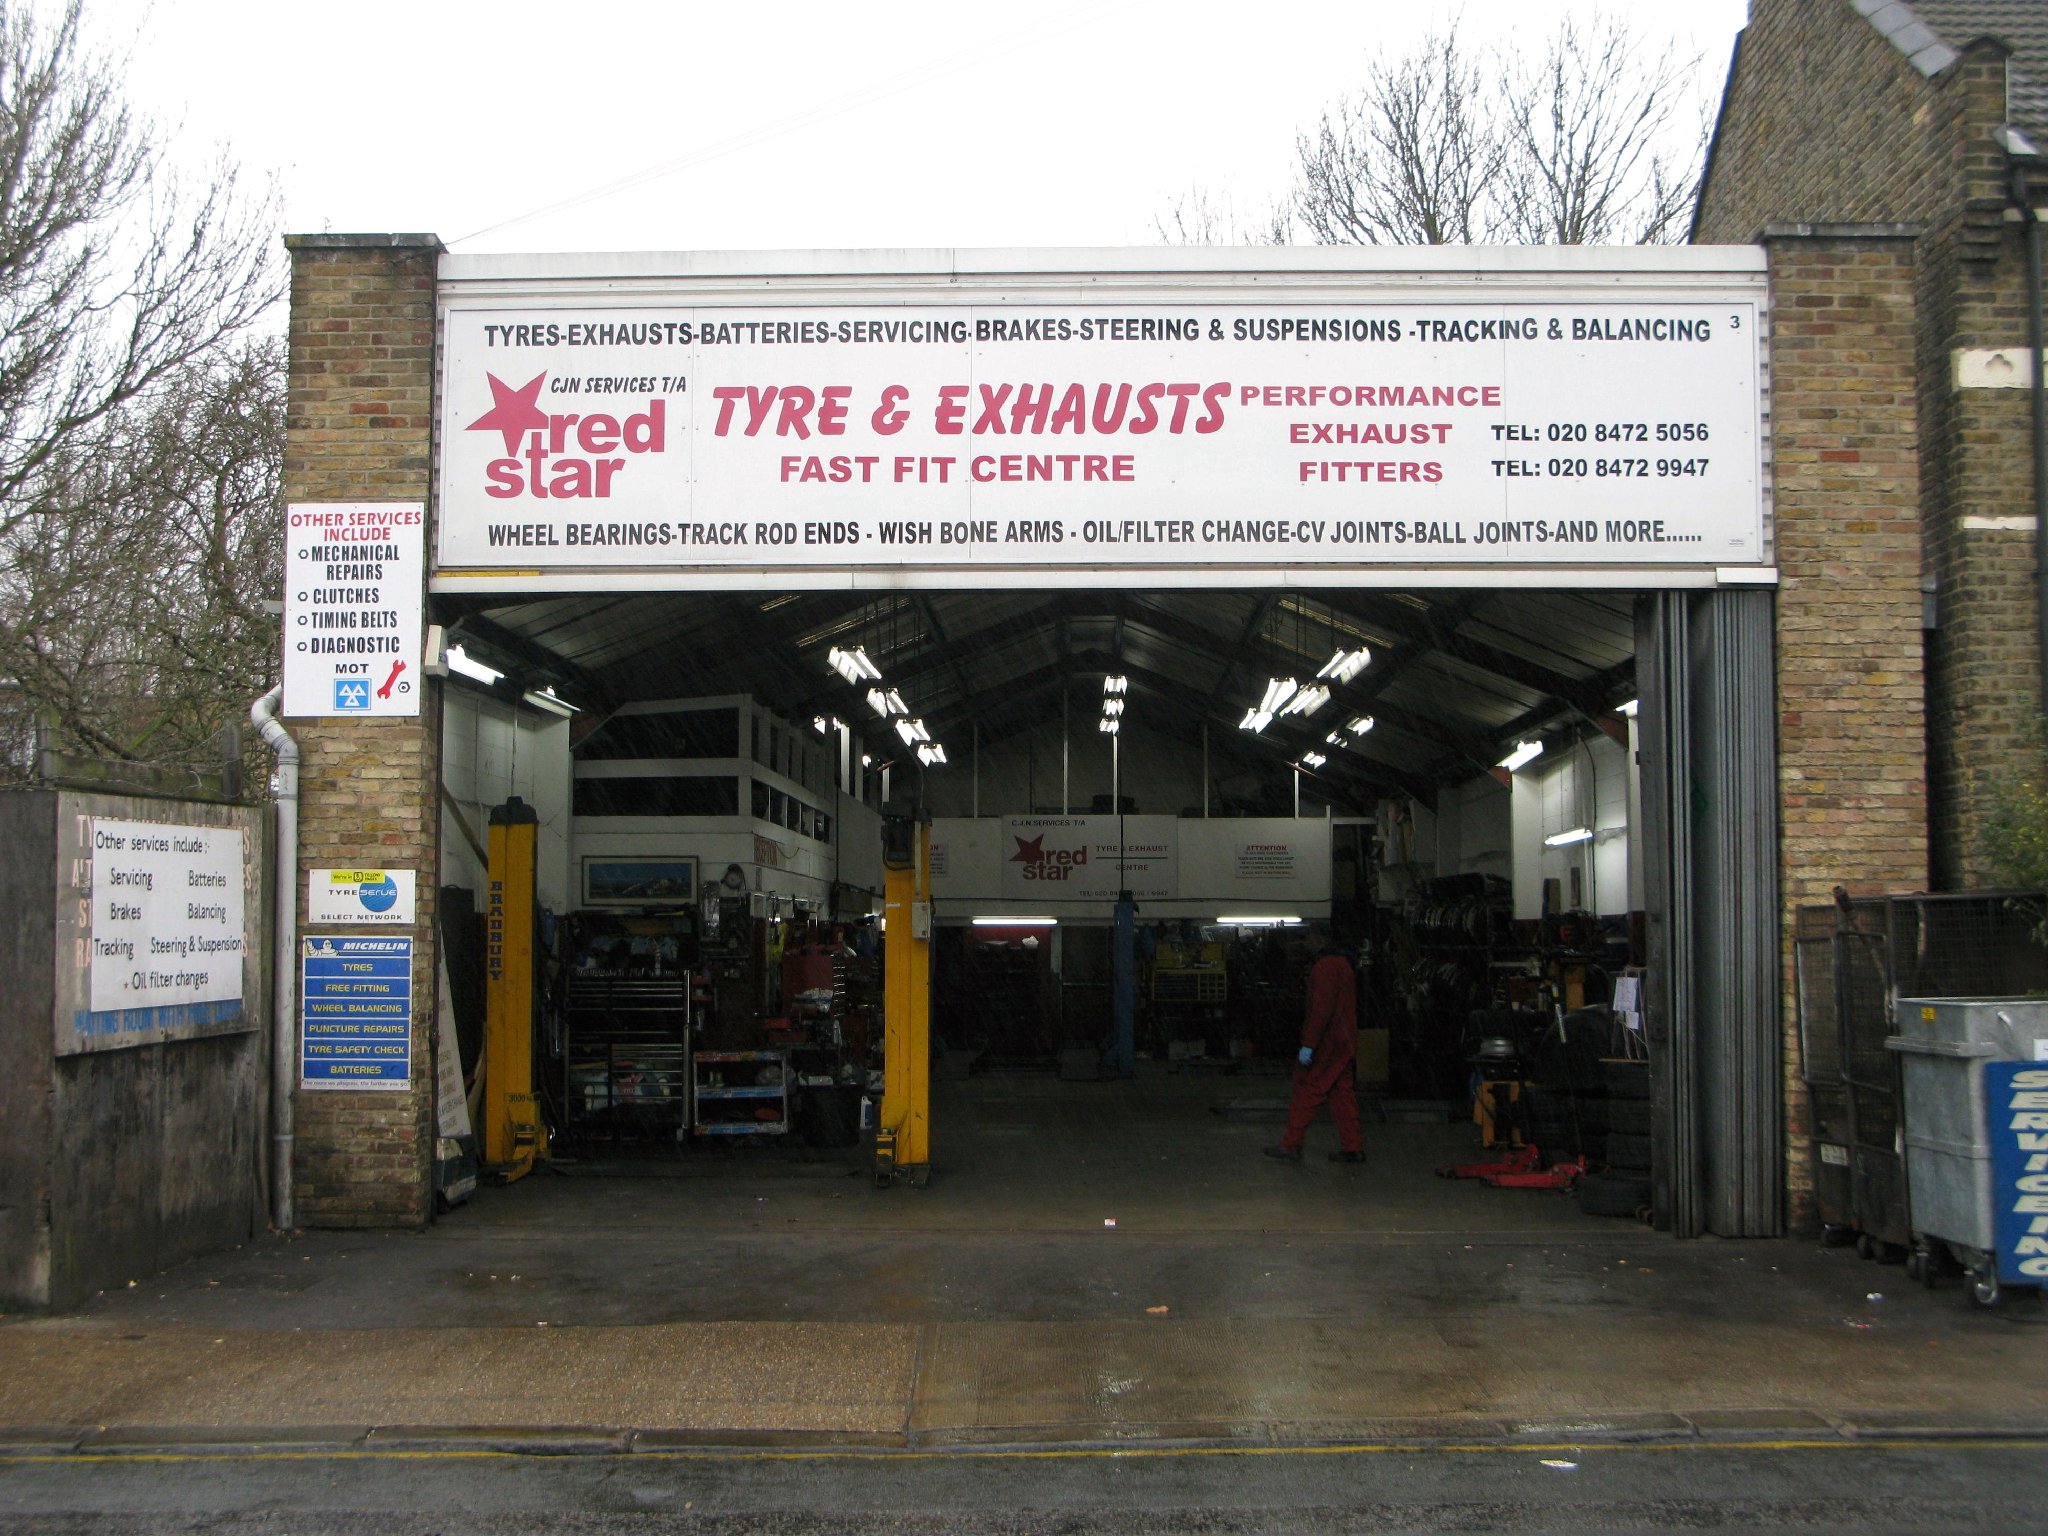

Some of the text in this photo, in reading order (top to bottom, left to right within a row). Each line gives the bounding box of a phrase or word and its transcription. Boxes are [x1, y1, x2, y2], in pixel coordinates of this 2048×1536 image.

[1208, 319, 1225, 341] &
[1233, 319, 1401, 342] SUSPENSIONS
[1547, 318, 1564, 341] &
[1573, 319, 1711, 343] BALANCING
[1730, 315, 1741, 329] 3
[550, 375, 687, 394] CJN SERVICES T/A
[1241, 386, 1501, 407] PERFORMANCE
[713, 382, 1232, 440] TYRE & EXHAUSTS
[550, 399, 666, 454] red
[1289, 423, 1453, 445] EXHAUST
[1491, 423, 1709, 442] TEL: 020 8472 5056
[485, 431, 626, 499] star
[780, 455, 1135, 483] FAST FIT CENTRE
[1299, 461, 1444, 483] FITTERS
[1491, 459, 1710, 478] TEL: 020 8472 9947
[291, 512, 421, 527] OTHER SERVICES
[324, 527, 391, 542] INCLUDE
[489, 524, 560, 547] WHEEL
[756, 522, 798, 545] ROD
[805, 522, 860, 545] ENDS
[879, 521, 932, 545] WISH
[940, 521, 998, 544] BONE
[1005, 521, 1064, 544] ARMS
[1083, 520, 1196, 543] OIL/FILTER
[311, 545, 400, 562] MECHANICAL
[326, 563, 383, 581] REPAIRS
[313, 587, 379, 604] CLUTCHES
[311, 611, 398, 629] TIMING BELTS
[311, 637, 400, 654] DIAGNOSTIC
[335, 663, 369, 674] MOT
[96, 831, 126, 851] Other
[131, 834, 169, 852] services
[1046, 846, 1088, 865] red
[111, 868, 153, 891] Servicing
[188, 870, 226, 888] Batteries
[1022, 862, 1073, 880] star
[111, 903, 142, 920] Brakes
[188, 903, 226, 923] Balancing
[489, 880, 504, 981] BRADBURY
[94, 938, 134, 960] Tracking
[150, 937, 187, 958] Steering
[188, 936, 197, 951] &
[198, 935, 242, 956] Suspension
[343, 942, 408, 951] MICHELIN
[342, 963, 373, 972] TYRES
[132, 971, 209, 990] Oil filter changes
[325, 984, 390, 992] FREE FITTING
[312, 1004, 402, 1013] WHEEL BALANCING
[309, 1025, 404, 1033] PUNCTURE REPAIRS
[308, 1045, 404, 1053] TYRE SAFETY CHECK
[330, 1065, 381, 1074] BATTERIES
